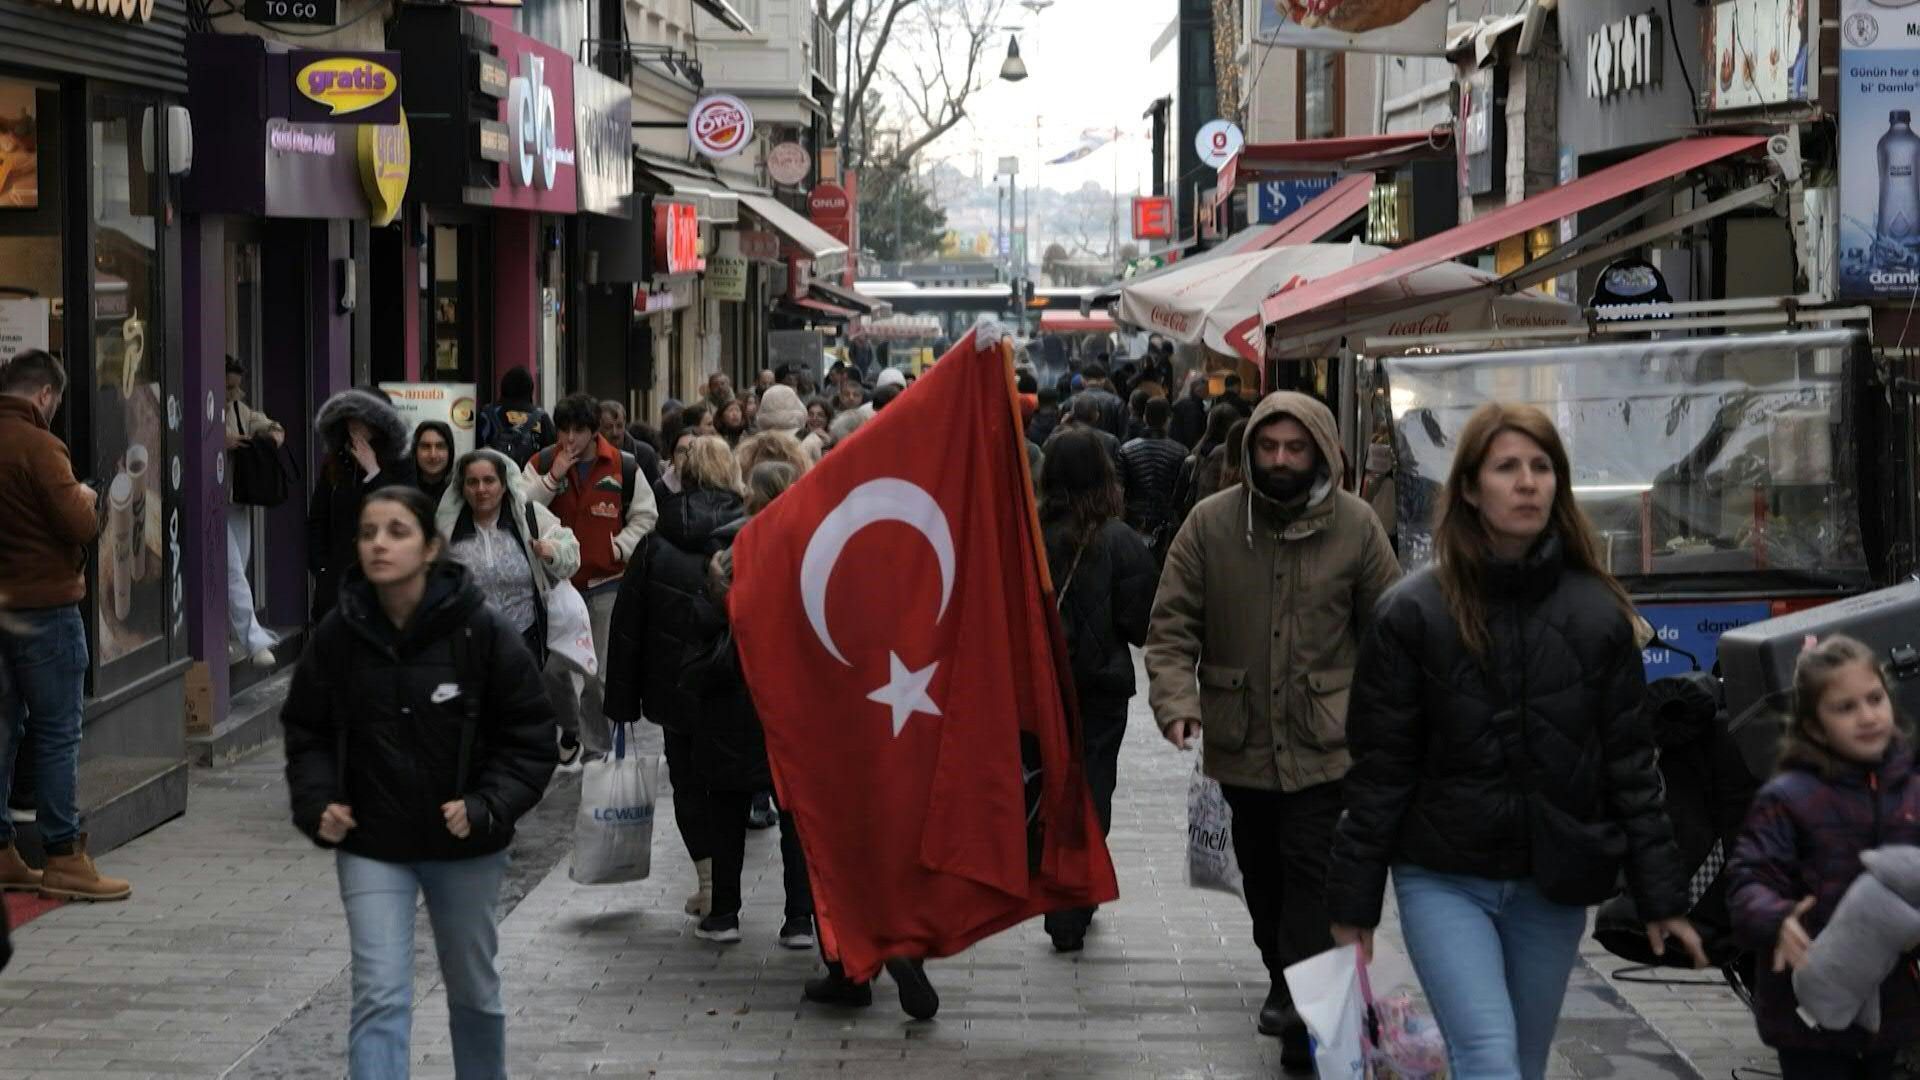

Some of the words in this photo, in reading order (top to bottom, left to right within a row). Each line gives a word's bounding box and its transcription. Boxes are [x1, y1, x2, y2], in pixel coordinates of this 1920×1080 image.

[265, 1, 287, 16] TO
[293, 3, 317, 18] GO
[308, 64, 386, 96] gratis
[811, 199, 846, 208] ONUR
[1140, 202, 1164, 236] E
